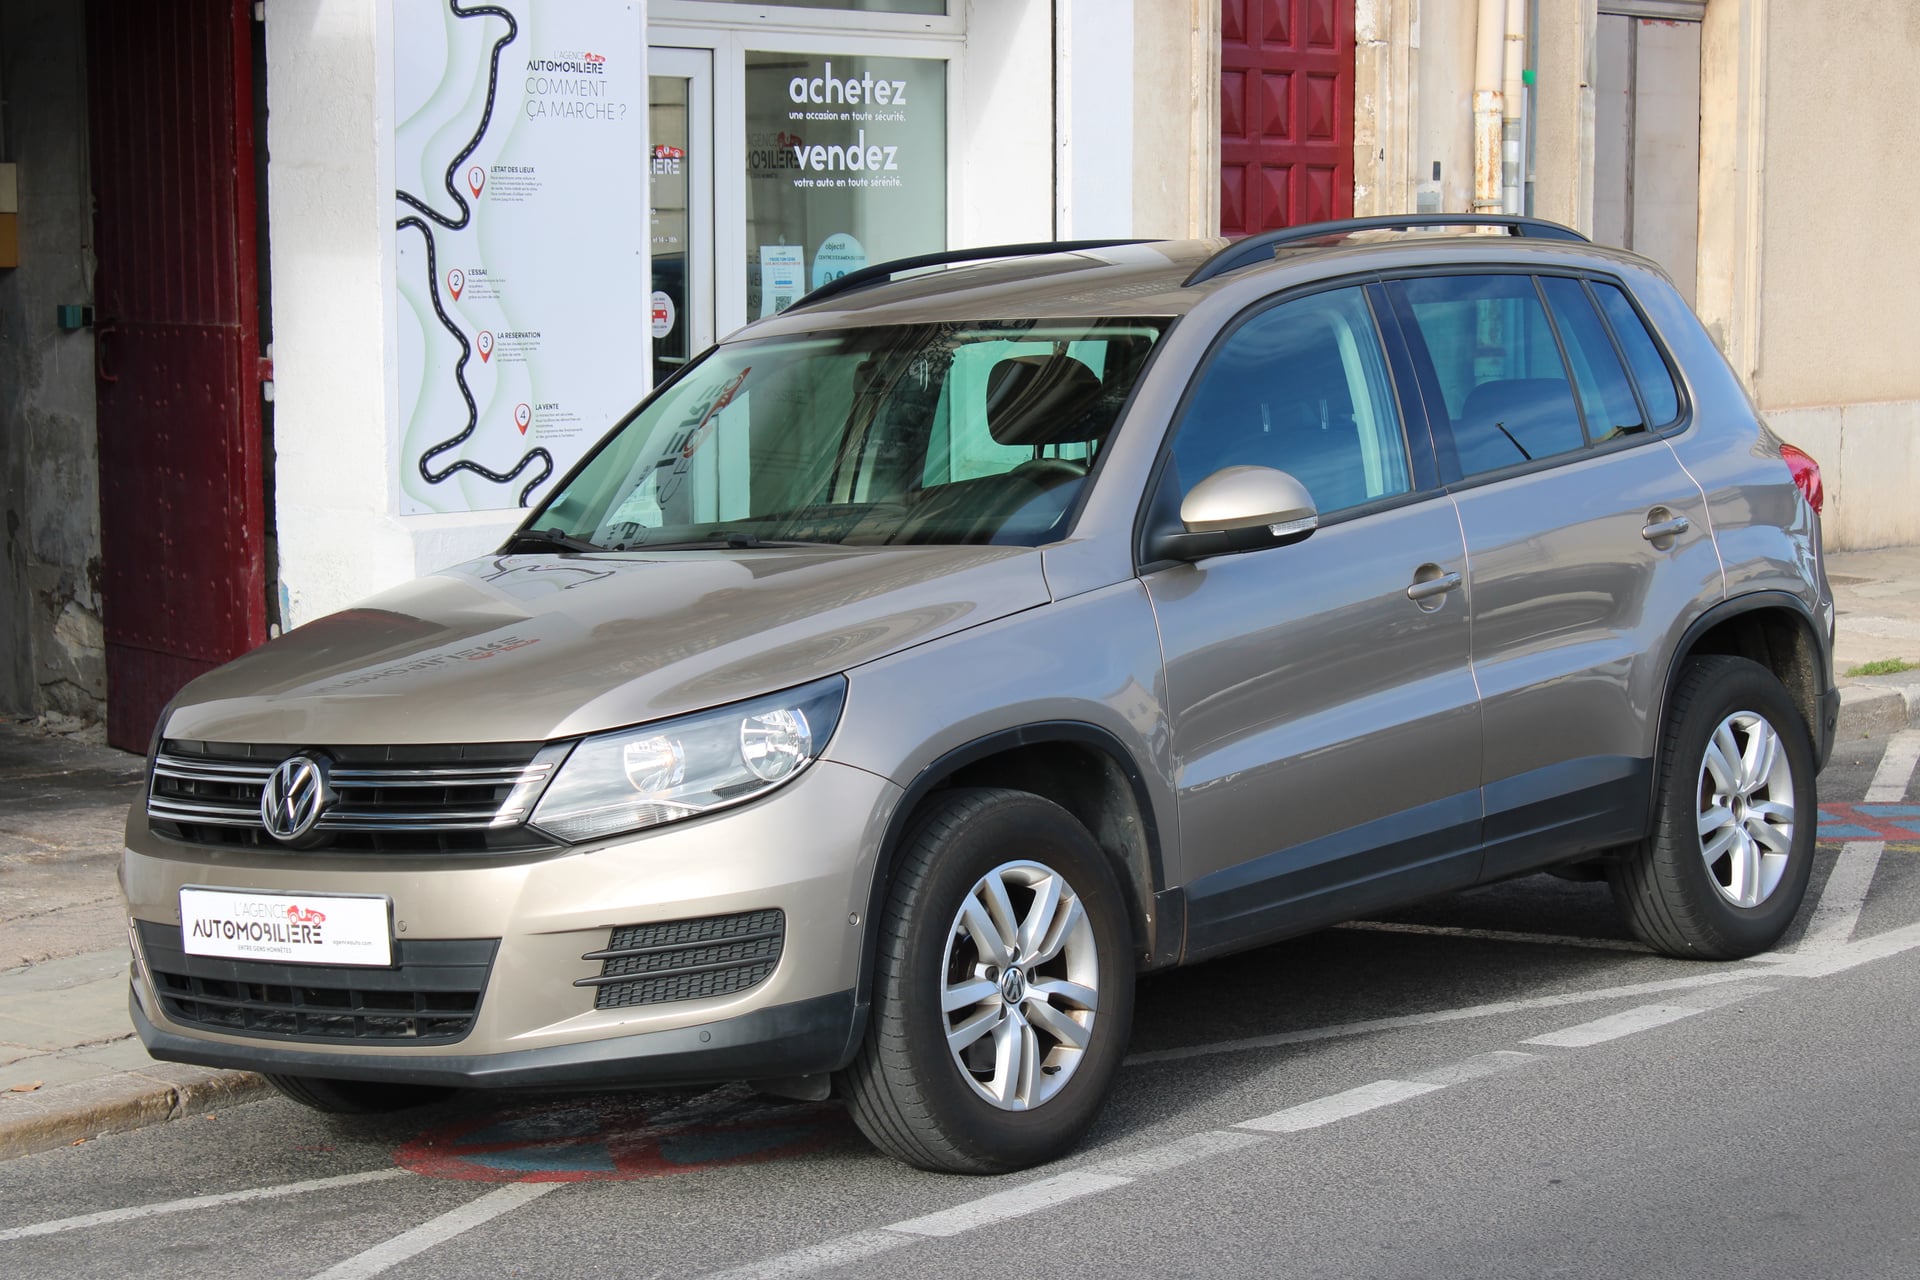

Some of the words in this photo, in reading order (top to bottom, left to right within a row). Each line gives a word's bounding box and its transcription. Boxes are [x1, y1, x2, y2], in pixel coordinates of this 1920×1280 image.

[525, 77, 608, 97] COMMENT
[788, 61, 907, 105] achetez
[526, 99, 547, 121] ÇA
[551, 101, 615, 120] MARCHE
[619, 103, 627, 120] ?
[788, 111, 804, 120] une
[806, 110, 839, 121] occasion
[840, 112, 850, 121] en
[852, 111, 873, 121] toute
[875, 110, 907, 122] sécurité.
[793, 128, 899, 171] vendez
[1379, 147, 1384, 162] 4
[519, 166, 535, 174] LIEUX
[650, 158, 680, 175] IERE
[793, 177, 814, 188] votre
[816, 177, 834, 188] auto
[836, 179, 845, 188] en
[848, 177, 869, 188] toute
[870, 175, 903, 188] sérénité.
[453, 274, 460, 286] 2
[482, 336, 489, 348] 3
[520, 410, 526, 419] 4
[233, 902, 288, 919] L'AGENCE
